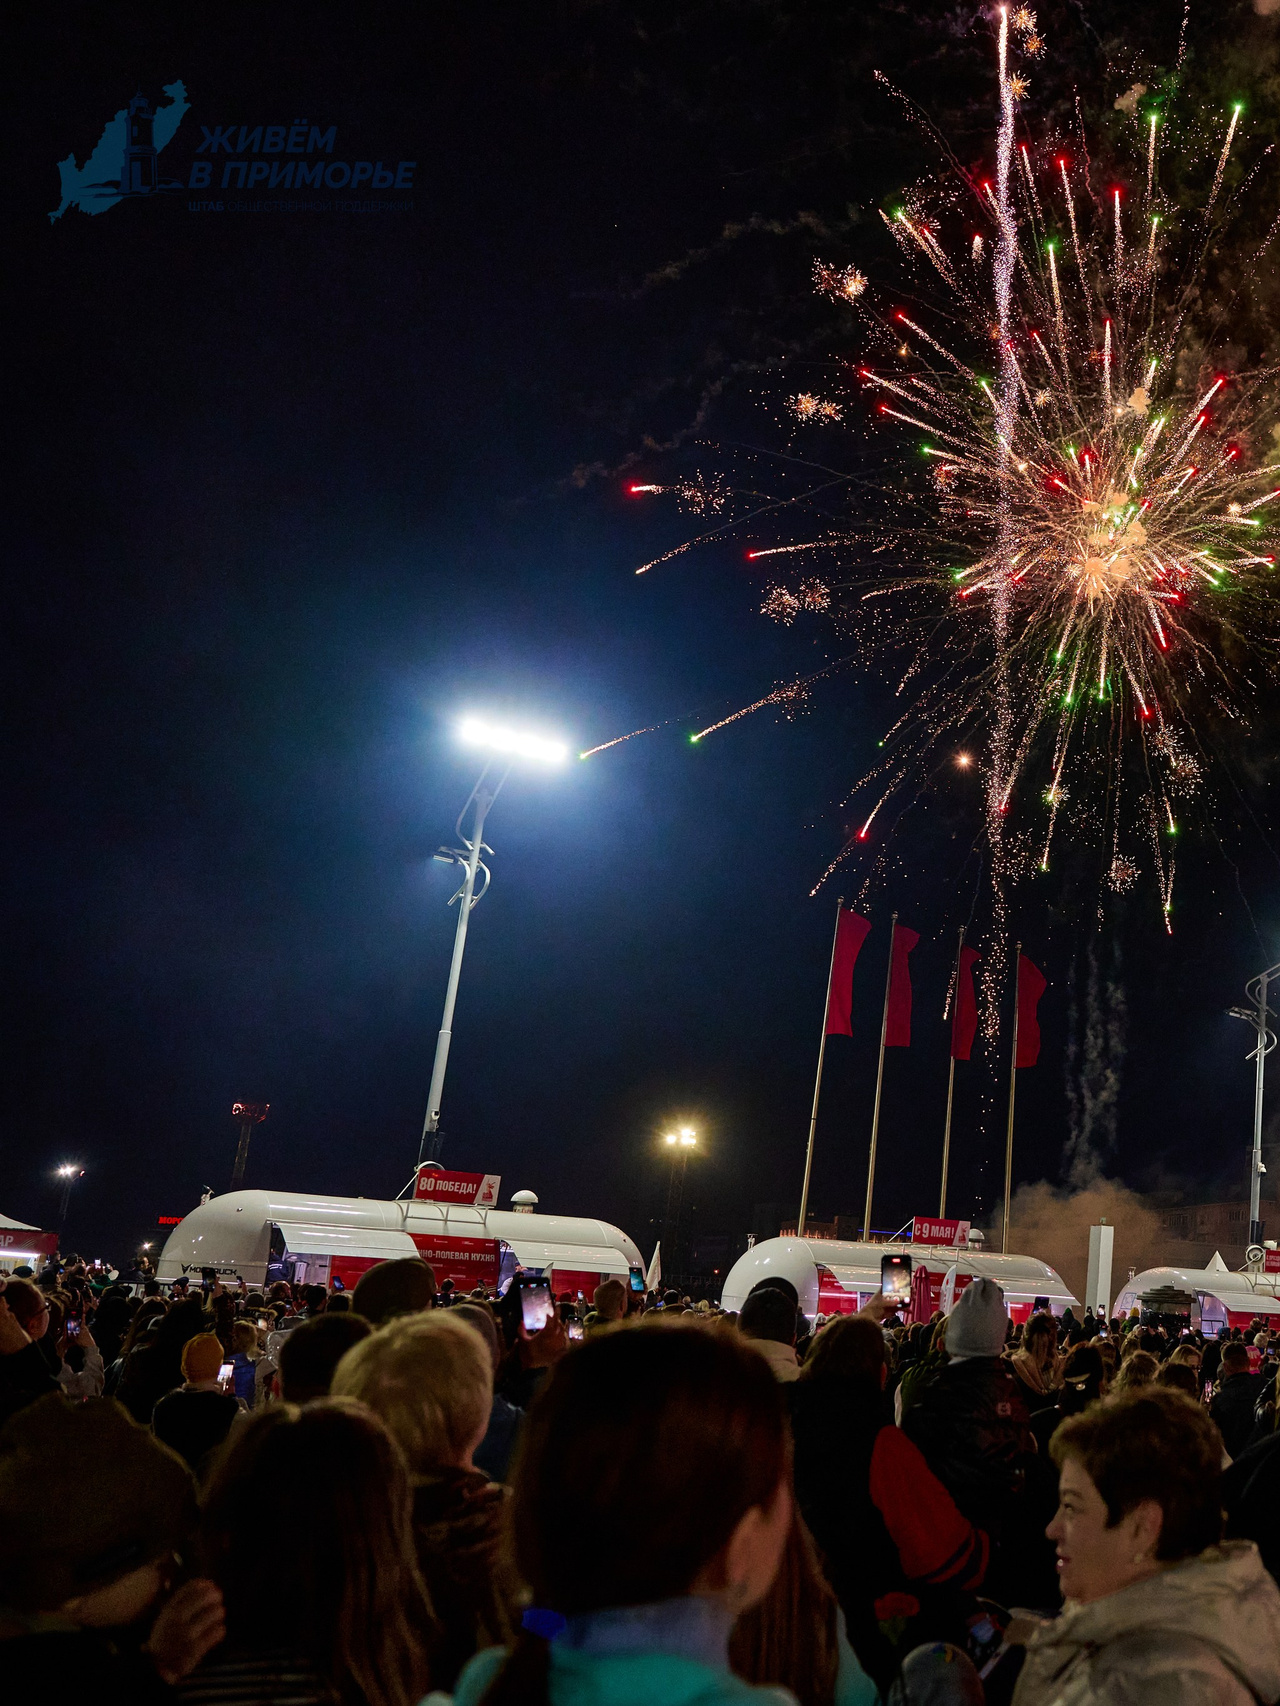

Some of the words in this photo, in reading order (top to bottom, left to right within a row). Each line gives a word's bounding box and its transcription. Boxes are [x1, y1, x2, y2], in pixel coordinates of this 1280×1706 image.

[419, 1177, 435, 1191] 80
[436, 1180, 477, 1194] ПОБЕДА!
[915, 1224, 921, 1235] С
[922, 1223, 930, 1238] 9
[931, 1225, 954, 1238] МАЯ!
[471, 1253, 496, 1262] КУХНЯ
